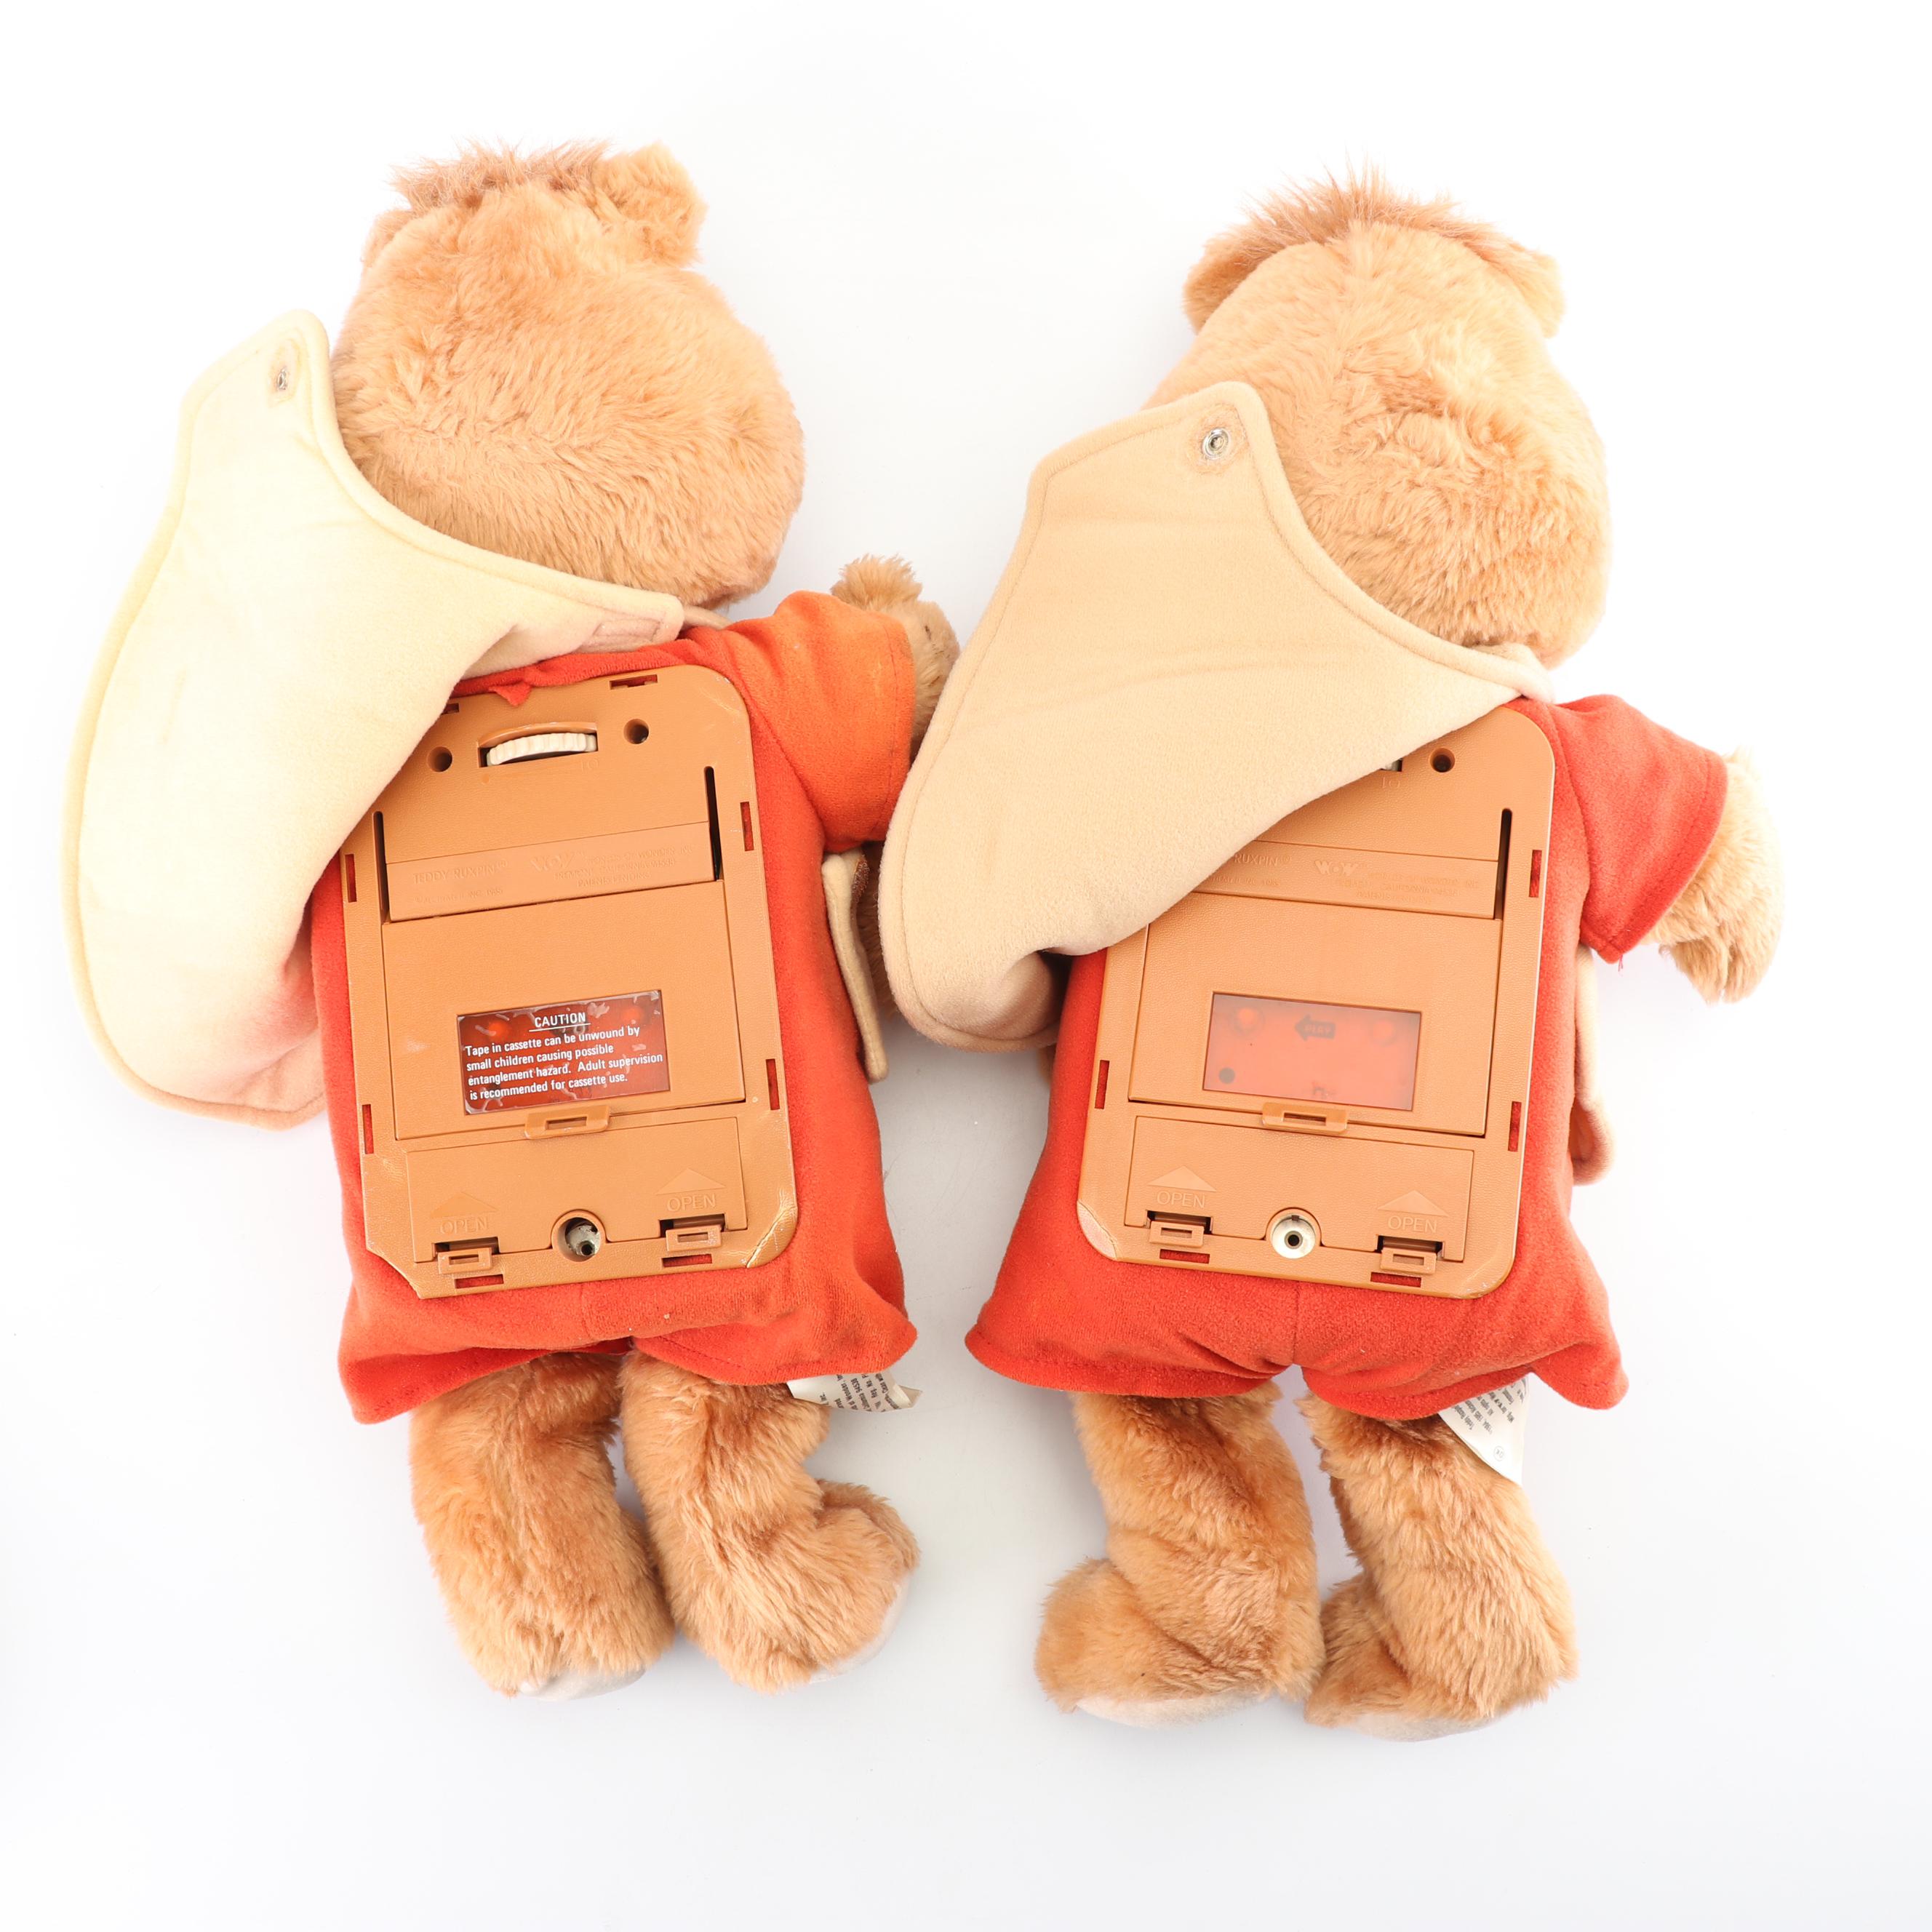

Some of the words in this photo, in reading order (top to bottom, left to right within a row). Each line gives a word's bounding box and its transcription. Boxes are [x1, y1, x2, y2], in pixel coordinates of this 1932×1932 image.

[412, 869, 449, 884] TEDDY
[535, 1013, 586, 1028] CAUTION
[466, 1045, 490, 1057] Tape
[492, 1043, 501, 1053] in
[505, 1039, 541, 1051] cassette
[544, 1037, 561, 1046] can
[564, 1033, 576, 1044] be
[579, 1026, 624, 1042] unwound
[628, 1025, 639, 1037] by
[466, 1058, 491, 1071] small
[495, 1054, 534, 1069] children
[537, 1050, 572, 1064] causing
[575, 1045, 613, 1058] possible
[468, 1069, 534, 1087] entanglement
[536, 1064, 571, 1077] hazard.
[578, 1061, 605, 1072] Adult
[609, 1053, 663, 1069] supervision
[470, 1090, 478, 1100] is
[480, 1079, 548, 1098] recommended
[551, 1079, 566, 1090] for
[568, 1076, 606, 1088] cassette
[609, 1074, 628, 1084] use.
[666, 1194, 716, 1212] OPEN
[1157, 1190, 1206, 1209] OPEN
[439, 1216, 488, 1234] OPEN
[1388, 1216, 1437, 1234] OPEN
